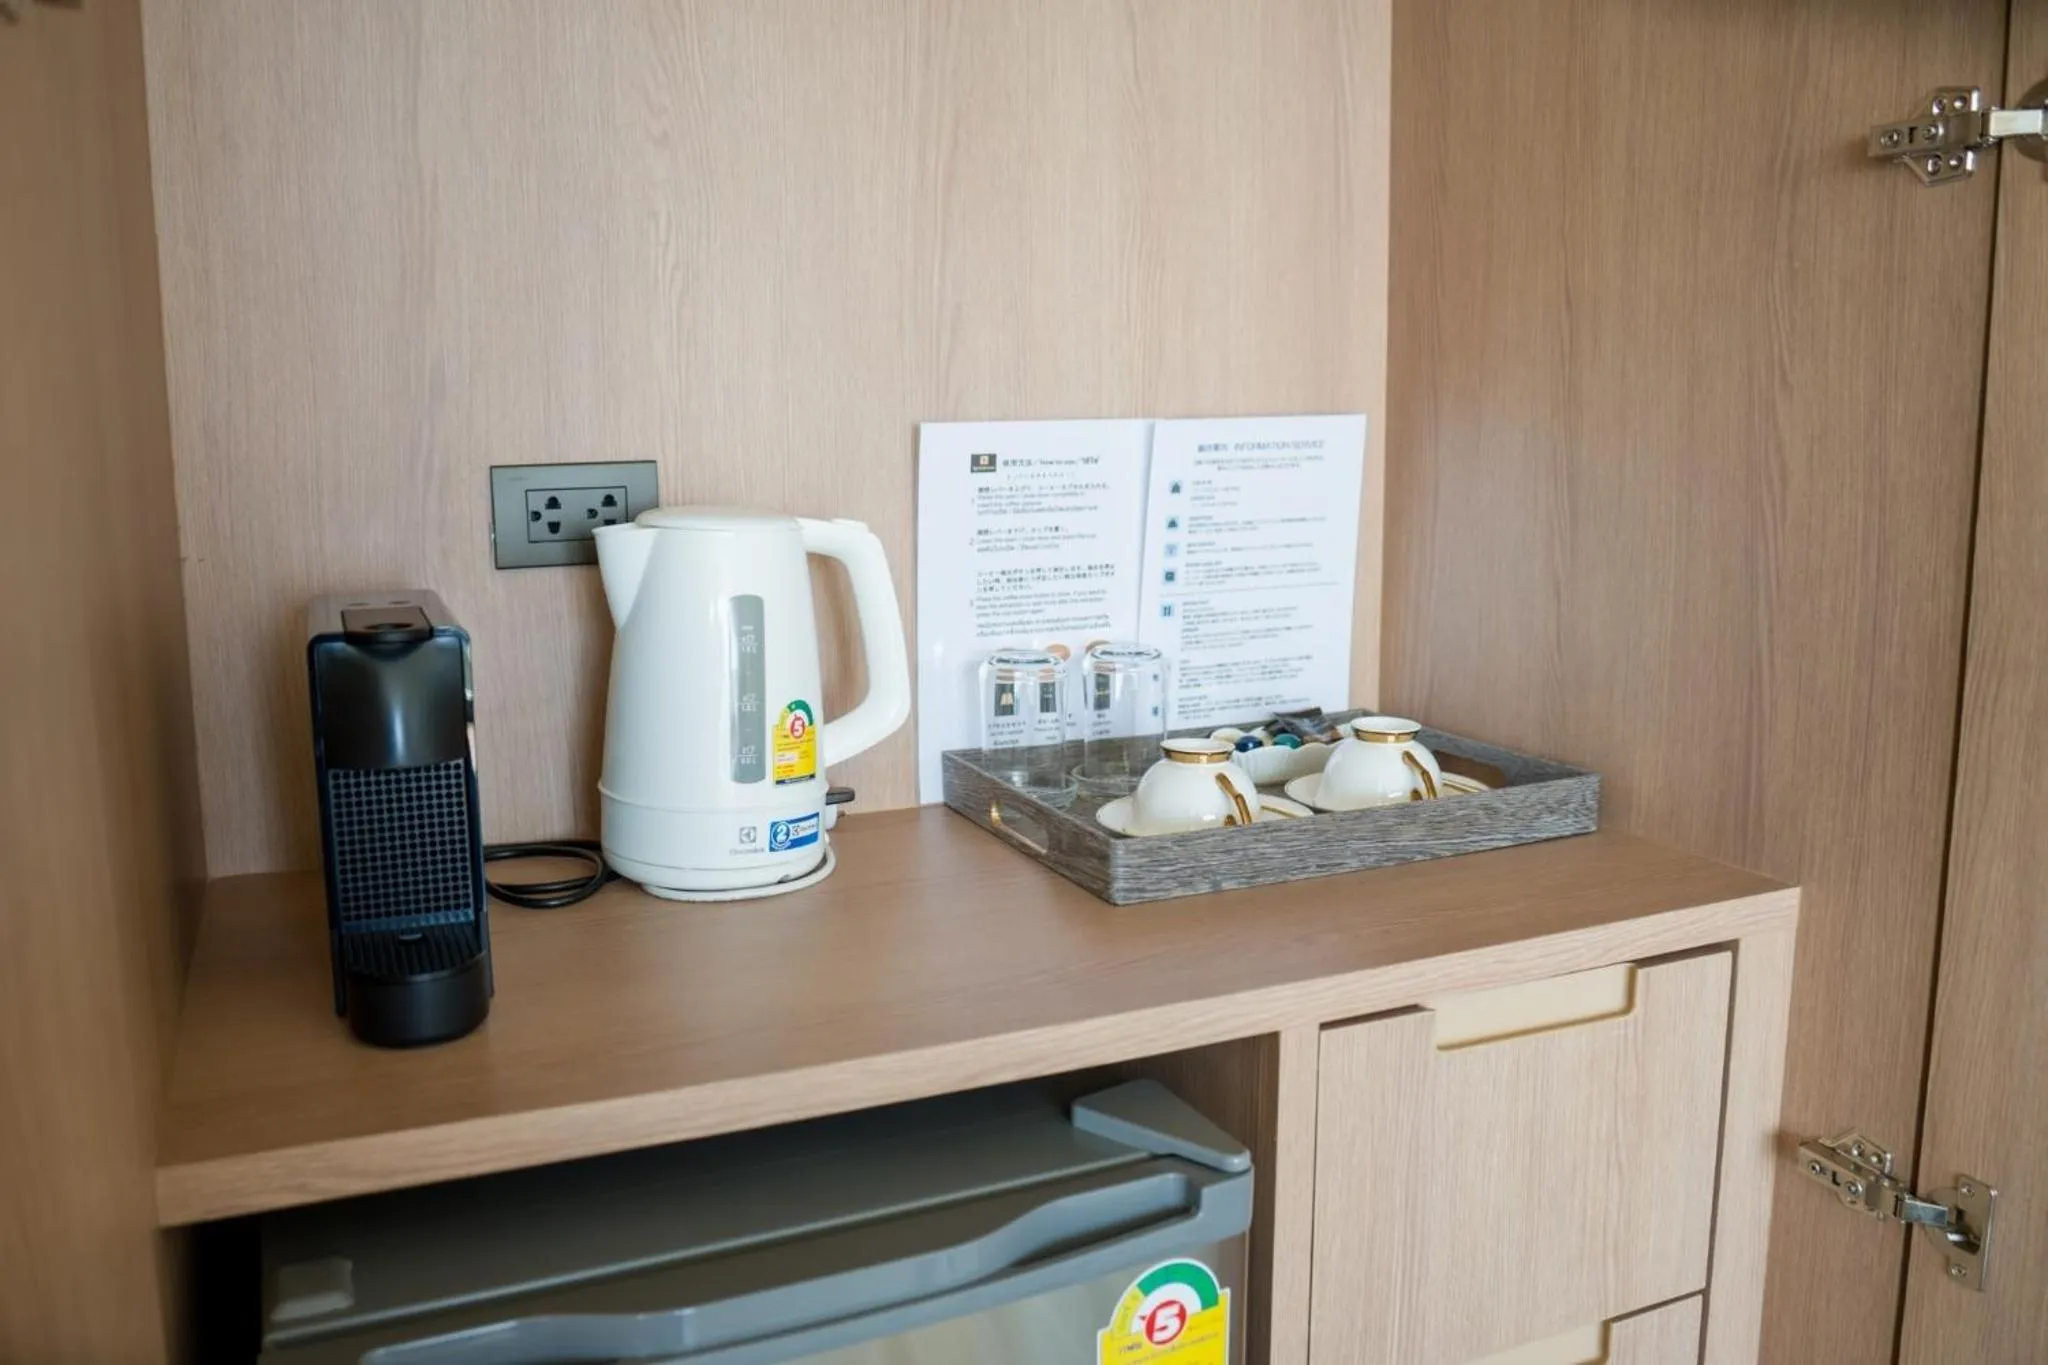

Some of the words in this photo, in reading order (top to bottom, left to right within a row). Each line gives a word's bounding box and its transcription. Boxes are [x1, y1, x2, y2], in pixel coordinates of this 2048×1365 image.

[793, 718, 804, 737] 5
[776, 825, 788, 843] 2
[1152, 1303, 1181, 1342] 5
